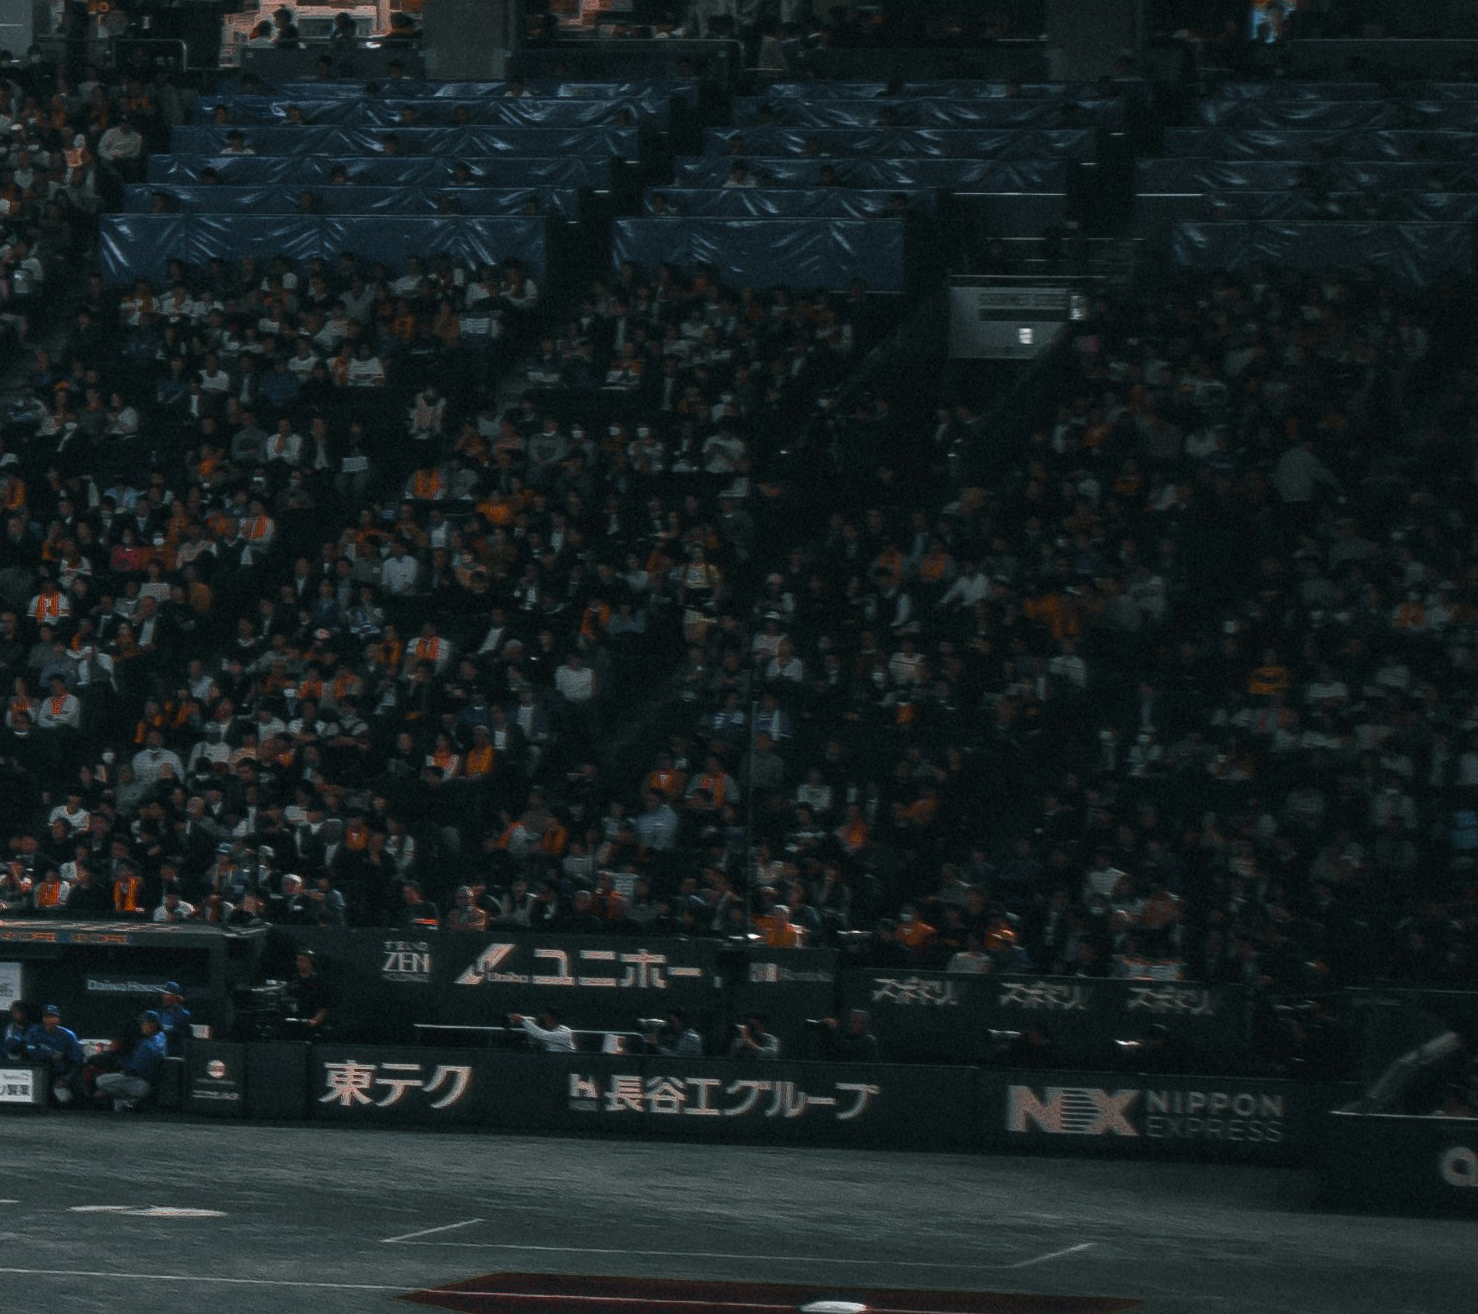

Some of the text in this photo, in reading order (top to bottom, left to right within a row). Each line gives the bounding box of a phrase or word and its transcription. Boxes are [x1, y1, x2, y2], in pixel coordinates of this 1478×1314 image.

[382, 951, 431, 973] ZEN
[531, 947, 703, 988] ユニホー
[86, 978, 126, 994] Daiwa
[317, 1059, 473, 1109] 東テク
[604, 1074, 881, 1119] 長谷工グループ
[1145, 1089, 1285, 1118] NIPPON
[1145, 1116, 1285, 1144] EXPRESS
